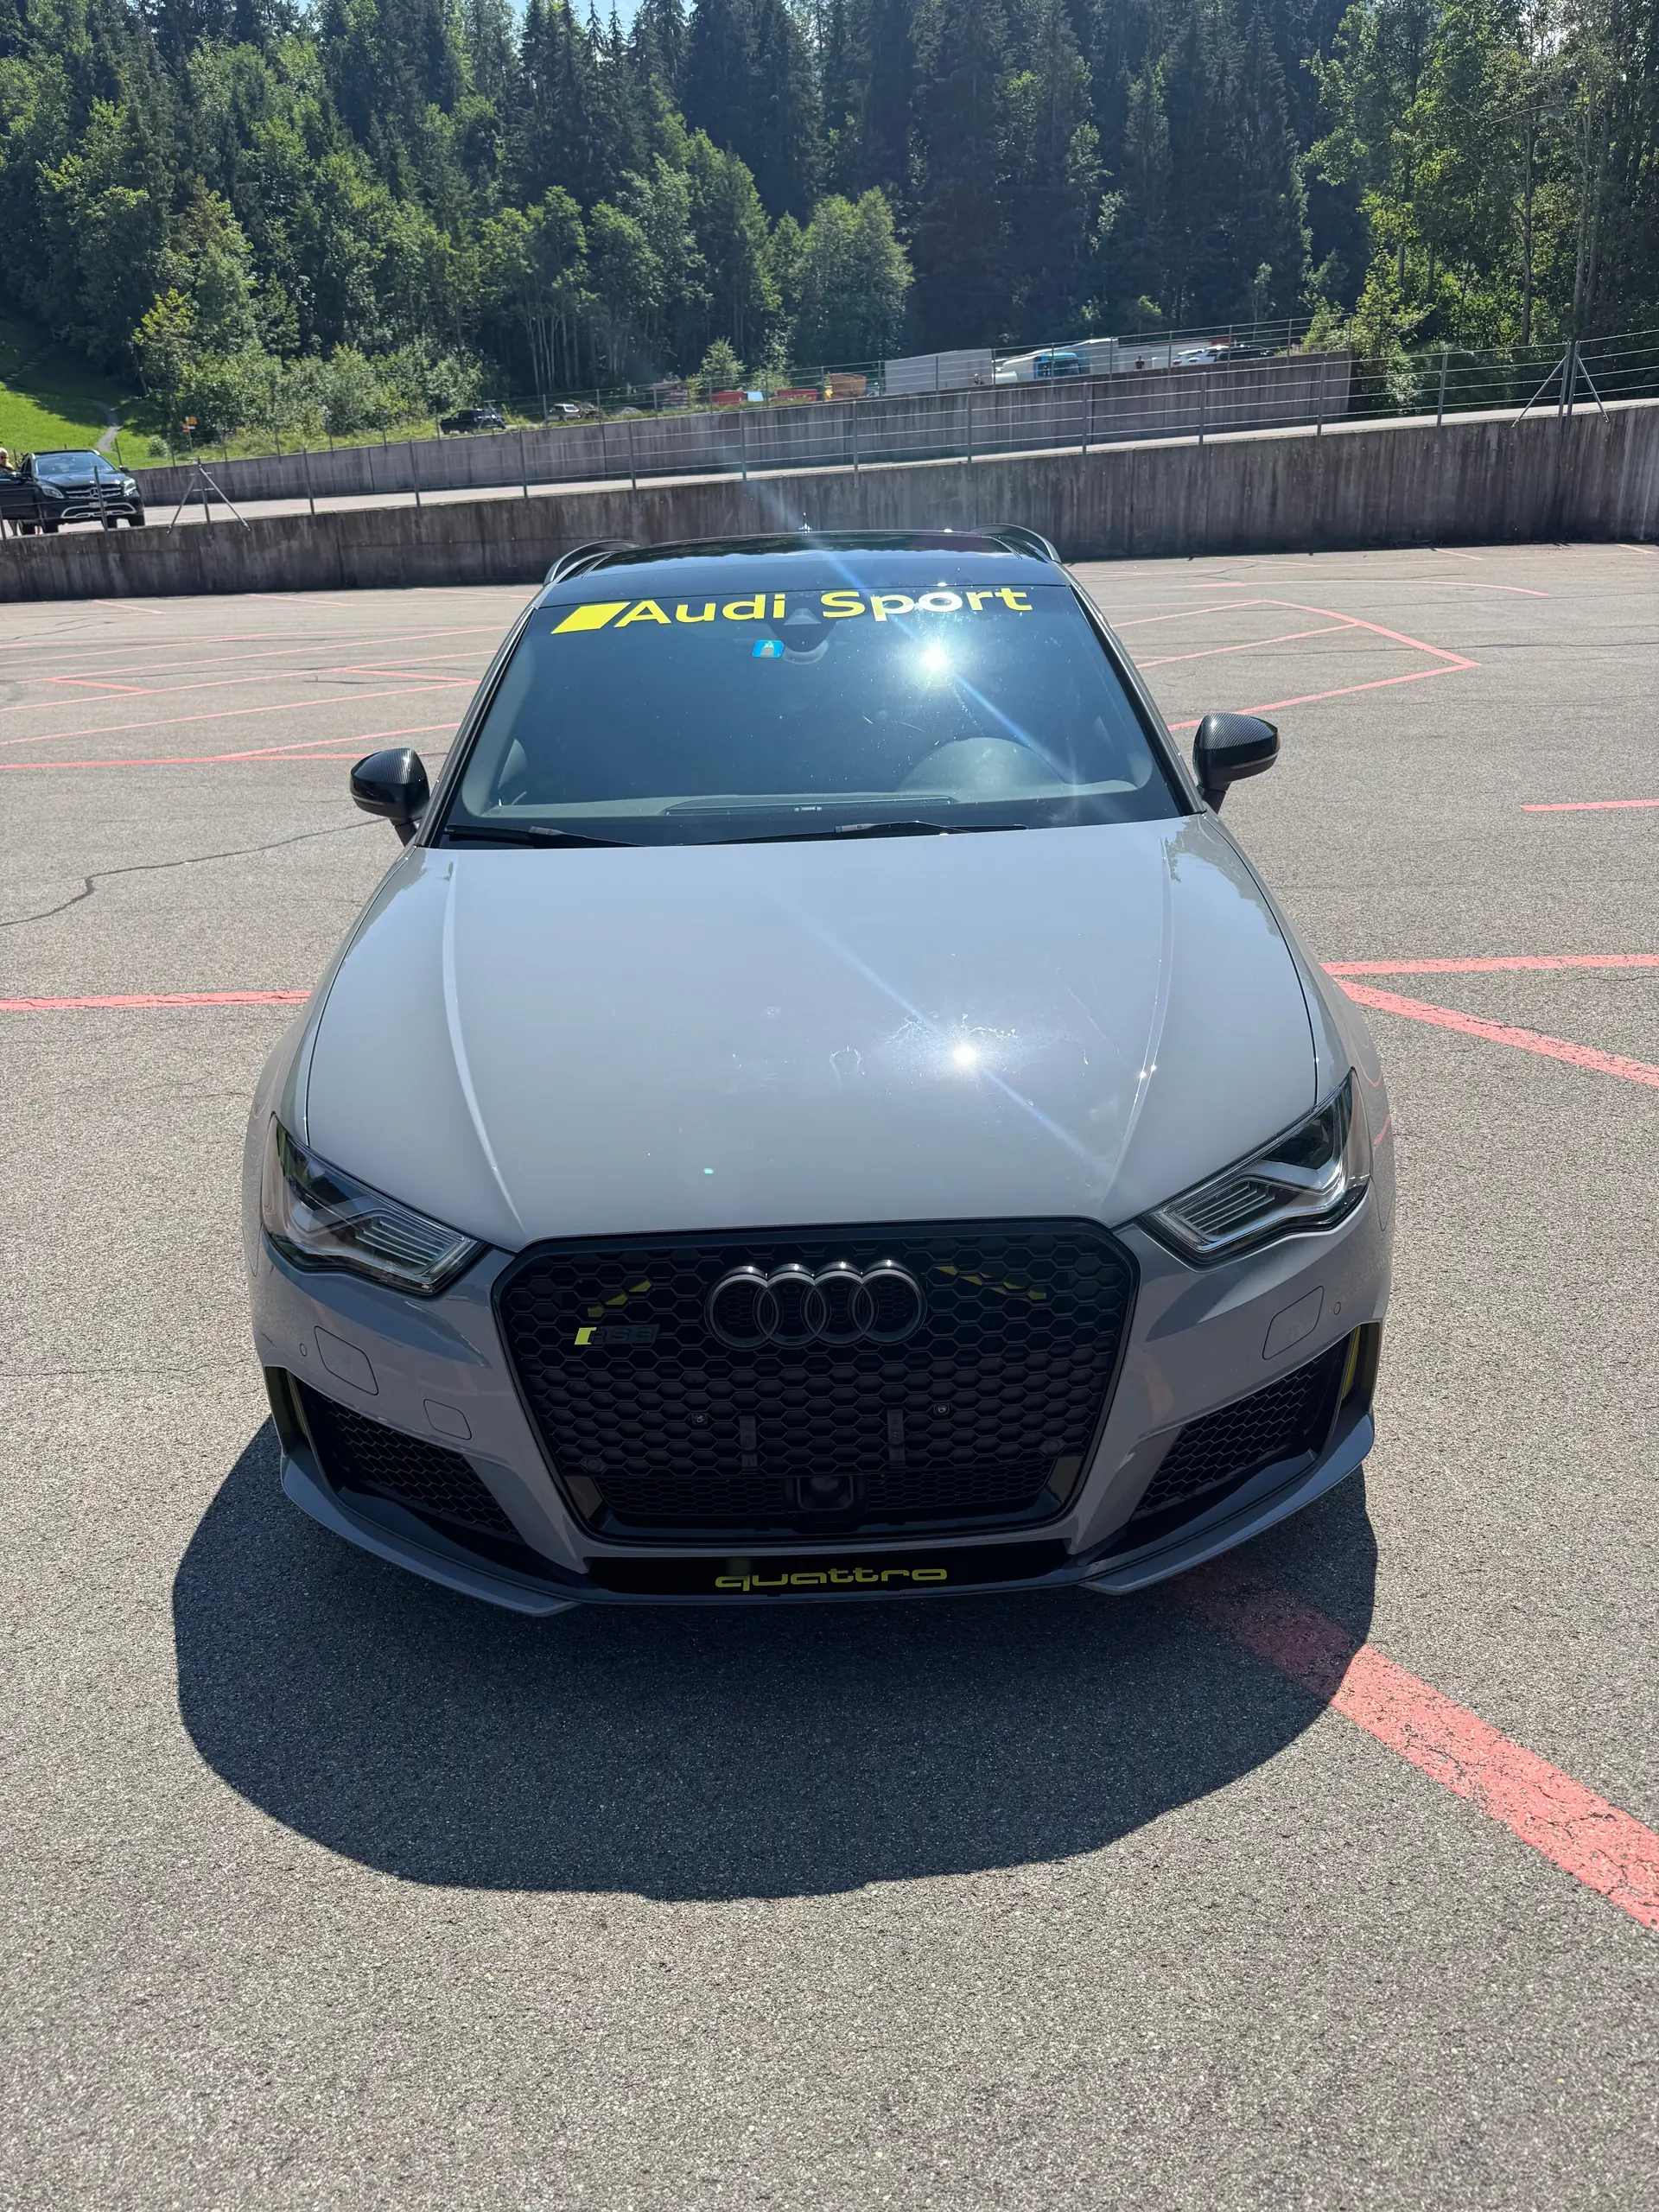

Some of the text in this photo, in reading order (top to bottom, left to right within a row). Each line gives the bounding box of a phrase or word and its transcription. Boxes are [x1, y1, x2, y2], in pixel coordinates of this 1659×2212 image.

[614, 588, 1033, 627] Audi Sport
[715, 1567, 948, 1592] quattro
